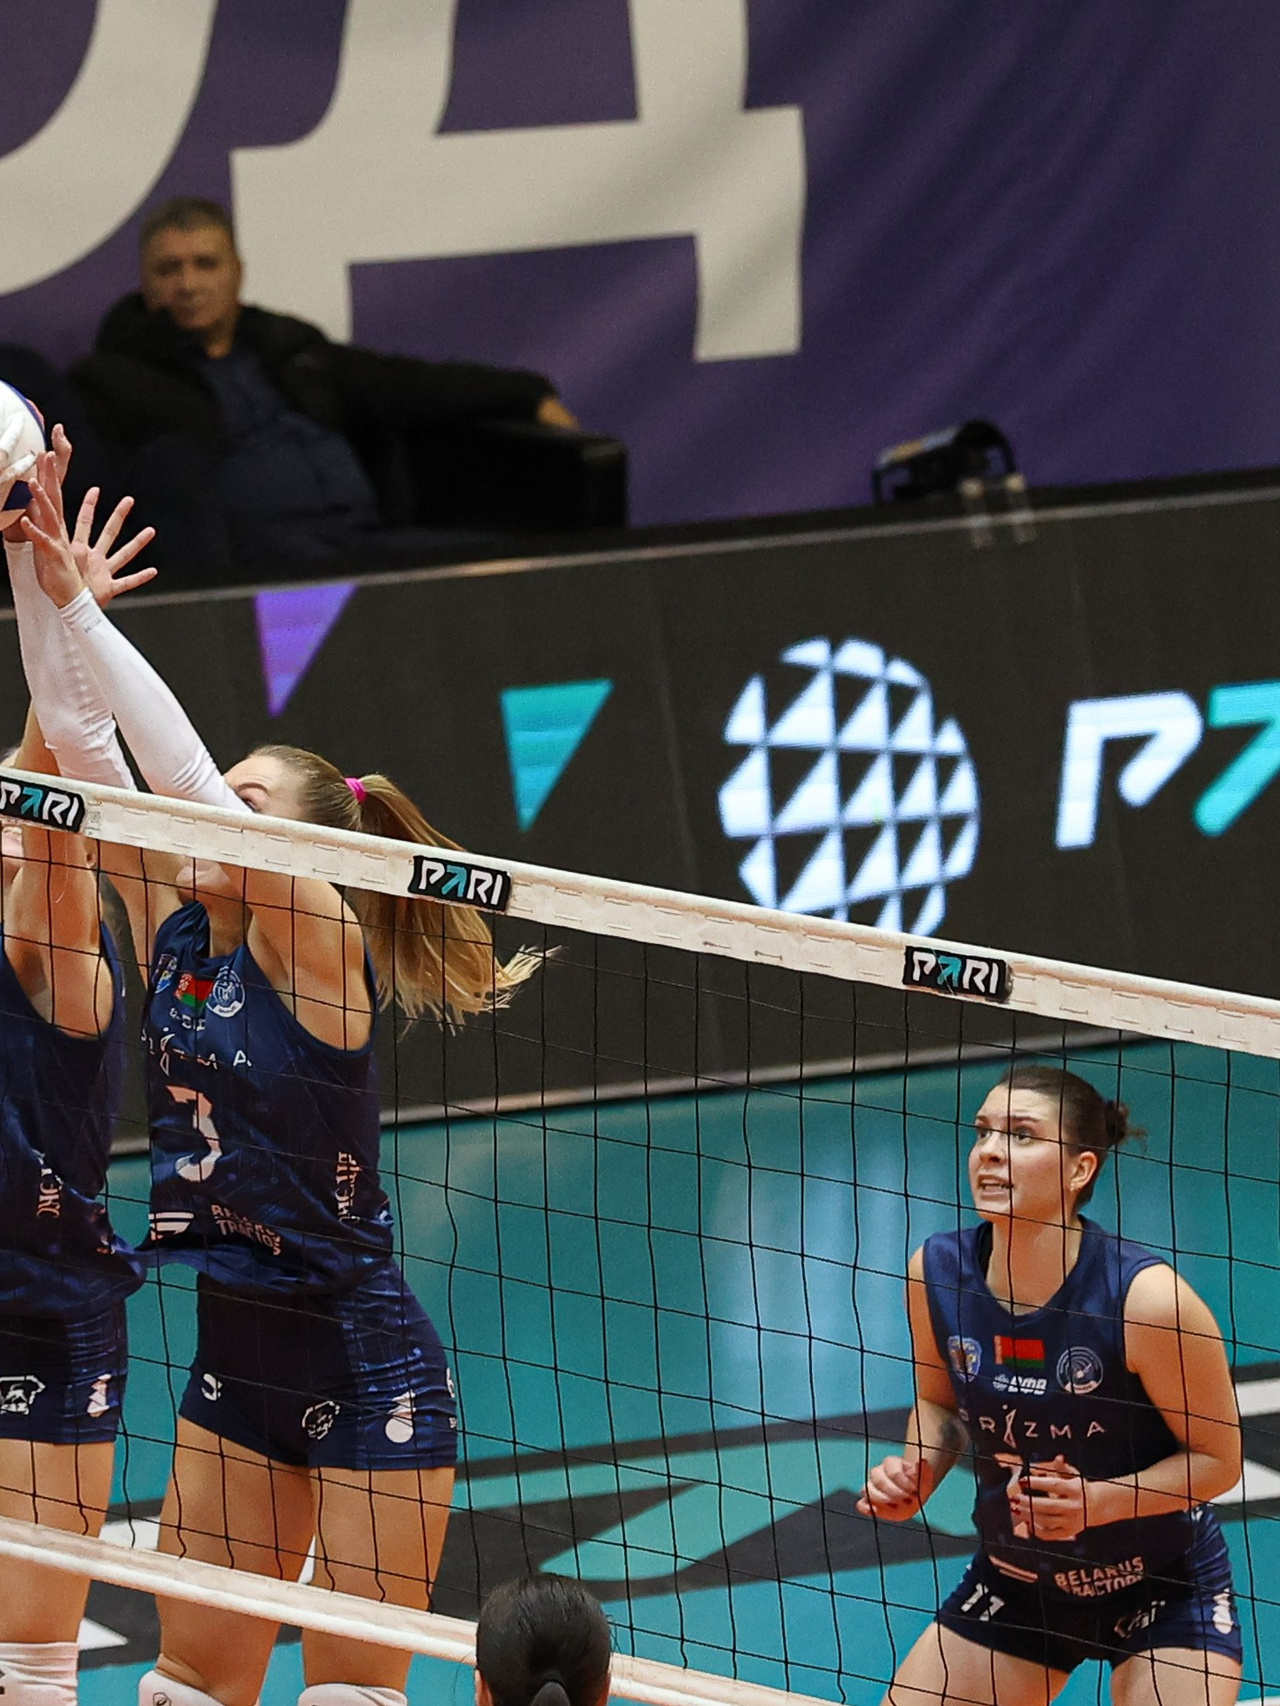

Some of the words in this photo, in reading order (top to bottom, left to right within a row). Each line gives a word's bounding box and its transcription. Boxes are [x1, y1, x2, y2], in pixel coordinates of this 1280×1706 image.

[418, 859, 504, 906] PARI
[912, 950, 999, 995] PARI
[165, 1085, 223, 1183] 3
